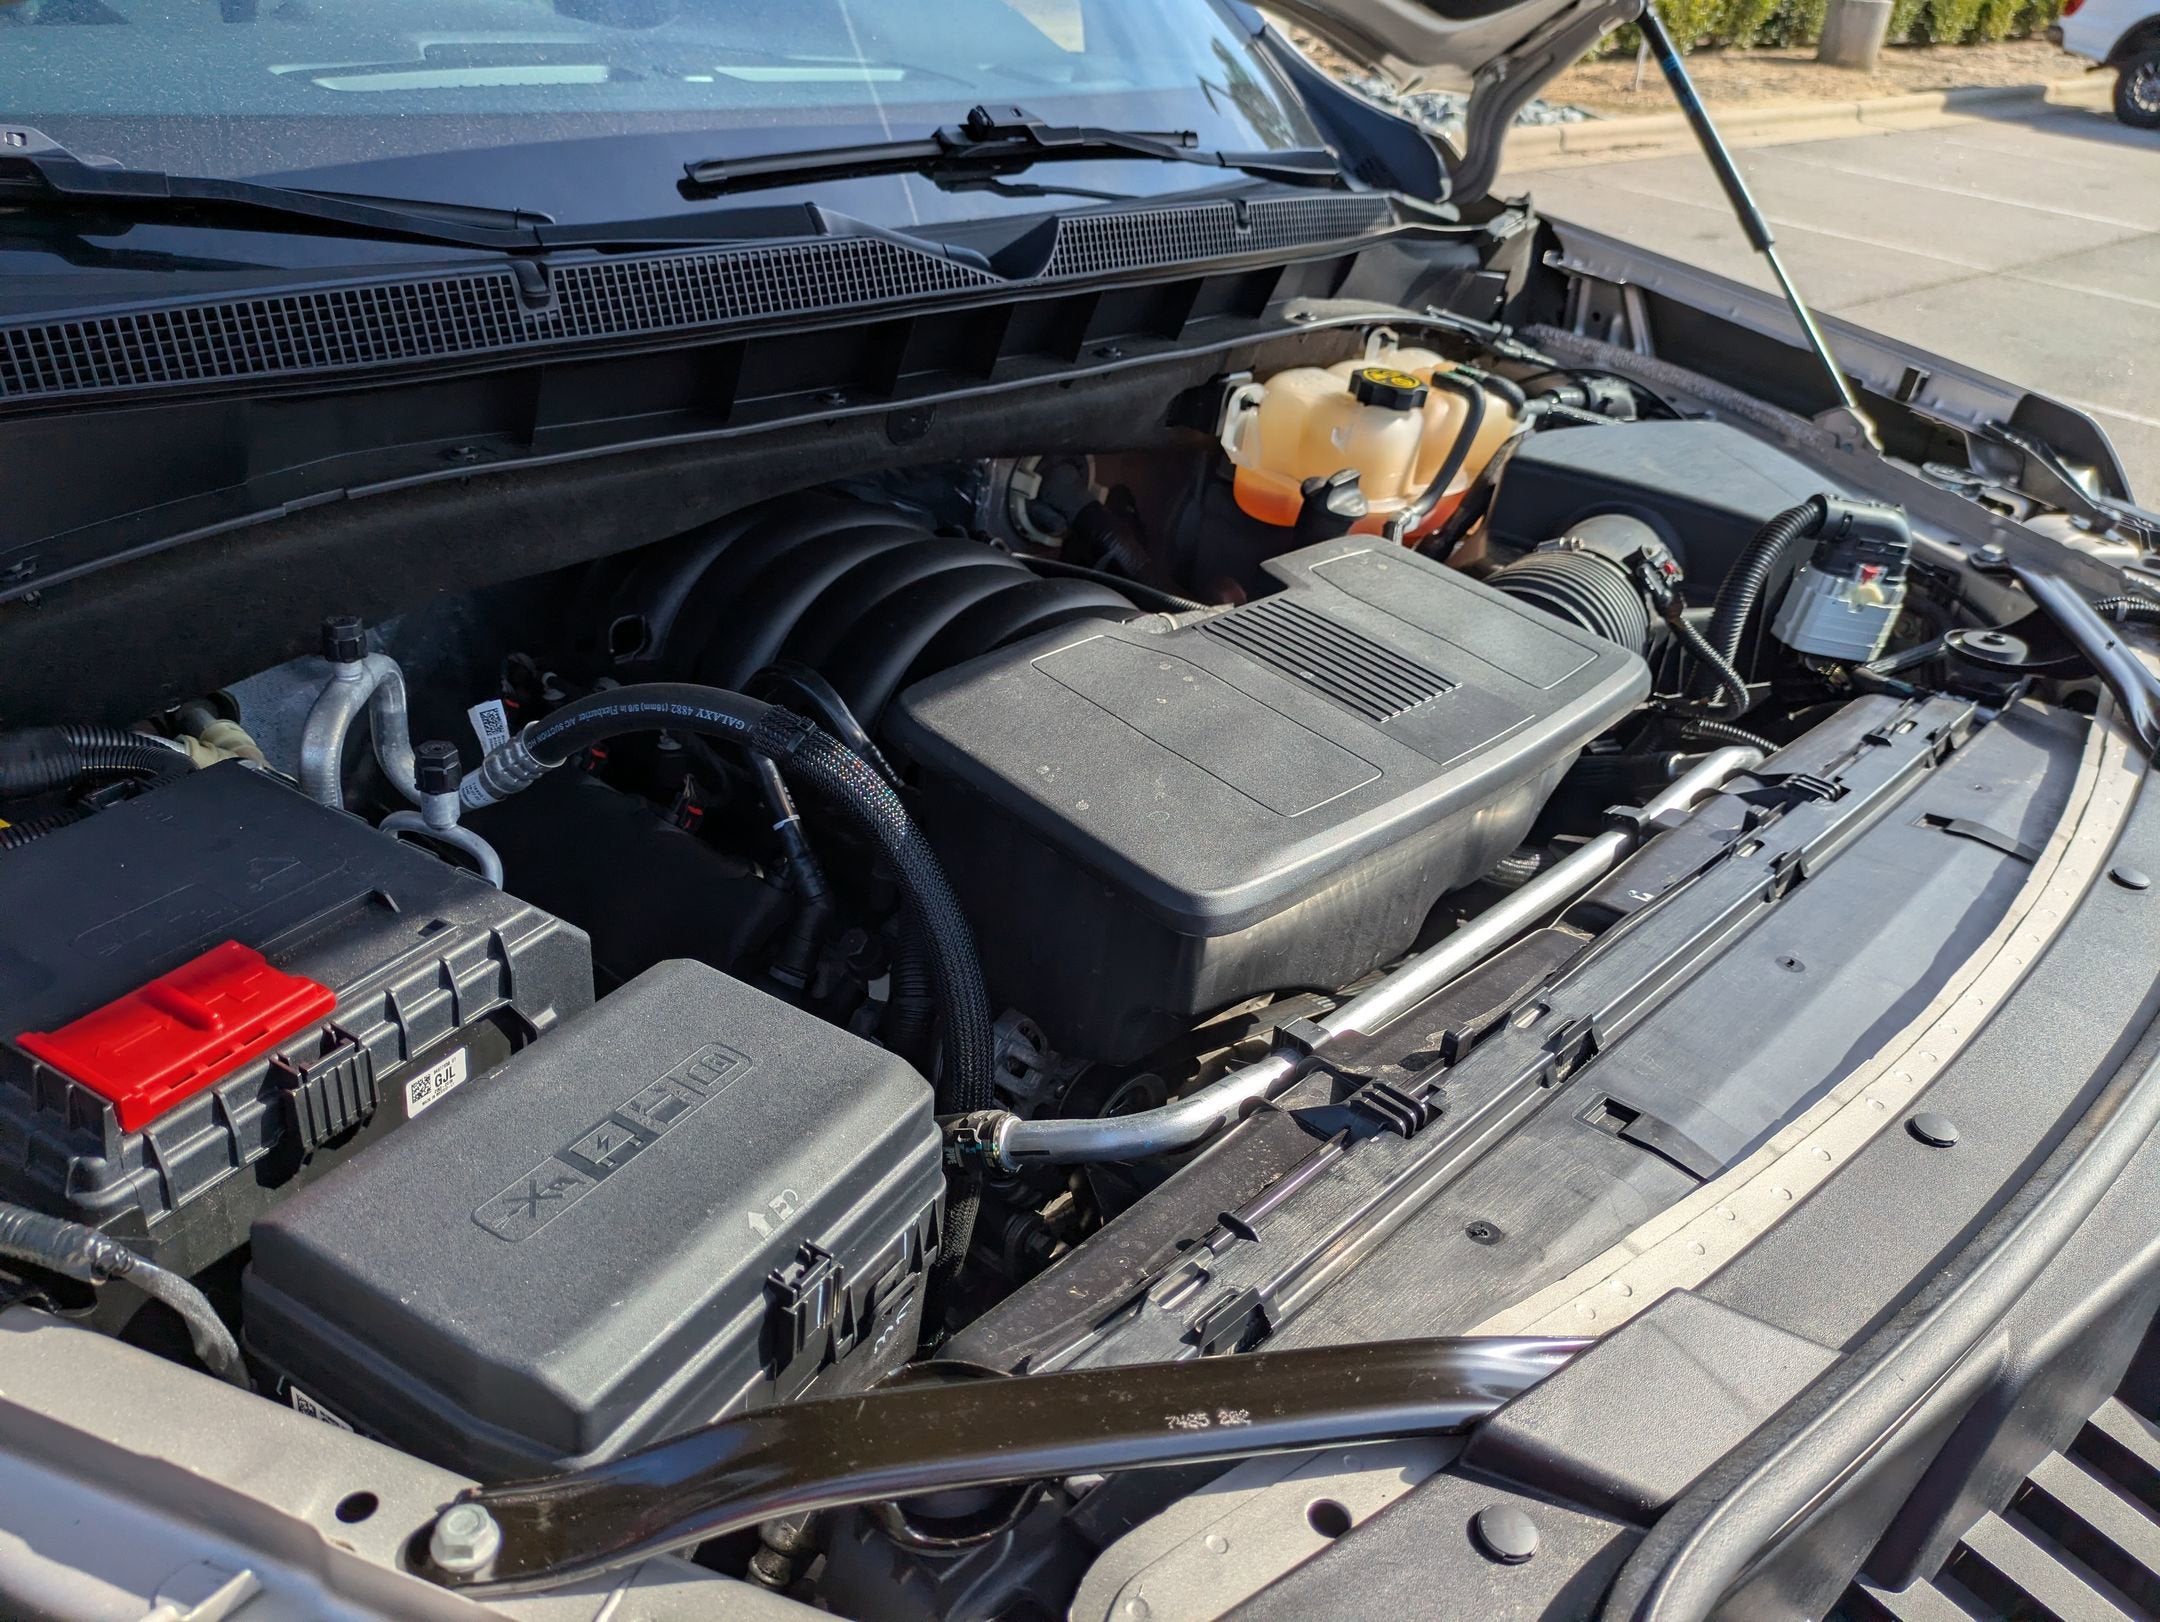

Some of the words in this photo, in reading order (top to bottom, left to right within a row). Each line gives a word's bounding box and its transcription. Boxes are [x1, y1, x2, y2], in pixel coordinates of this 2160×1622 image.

[671, 704, 694, 716] 4882
[696, 708, 745, 730] GALAXY
[538, 723, 564, 741] SUCTION
[434, 1066, 456, 1087] GJL
